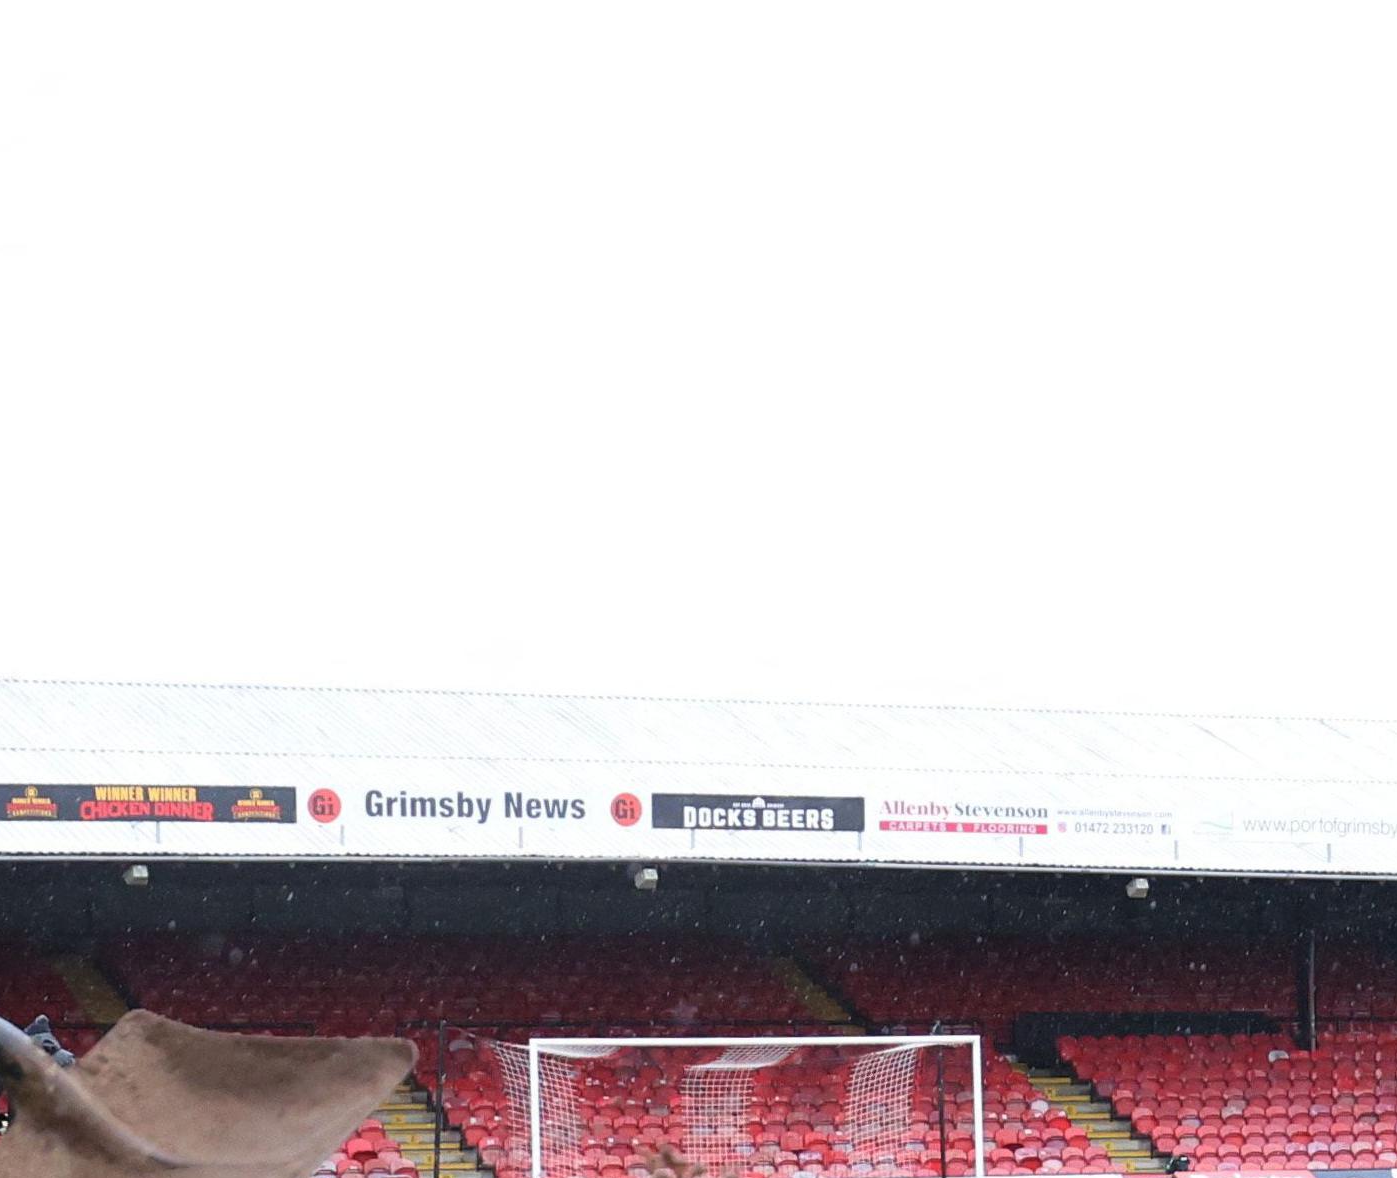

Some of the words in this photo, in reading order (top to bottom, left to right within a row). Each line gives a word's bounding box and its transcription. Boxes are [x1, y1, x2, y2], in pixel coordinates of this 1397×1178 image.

[94, 786, 144, 801] WINNER
[148, 787, 197, 801] WINNER
[79, 800, 150, 820] CHICKEN
[155, 801, 214, 821] DINNER
[312, 794, 335, 817] Gi
[365, 790, 492, 824] Grimsby
[504, 792, 587, 819] News
[614, 798, 637, 820] Gi
[879, 799, 951, 820] Allenby
[954, 800, 1049, 819] Stevenson
[683, 806, 757, 828] DOCKS
[762, 808, 835, 830] BEERS
[888, 821, 948, 833] CARPETS
[973, 824, 1038, 835] FLOORING
[1074, 822, 1110, 834] 01472
[1112, 823, 1155, 836] 233120
